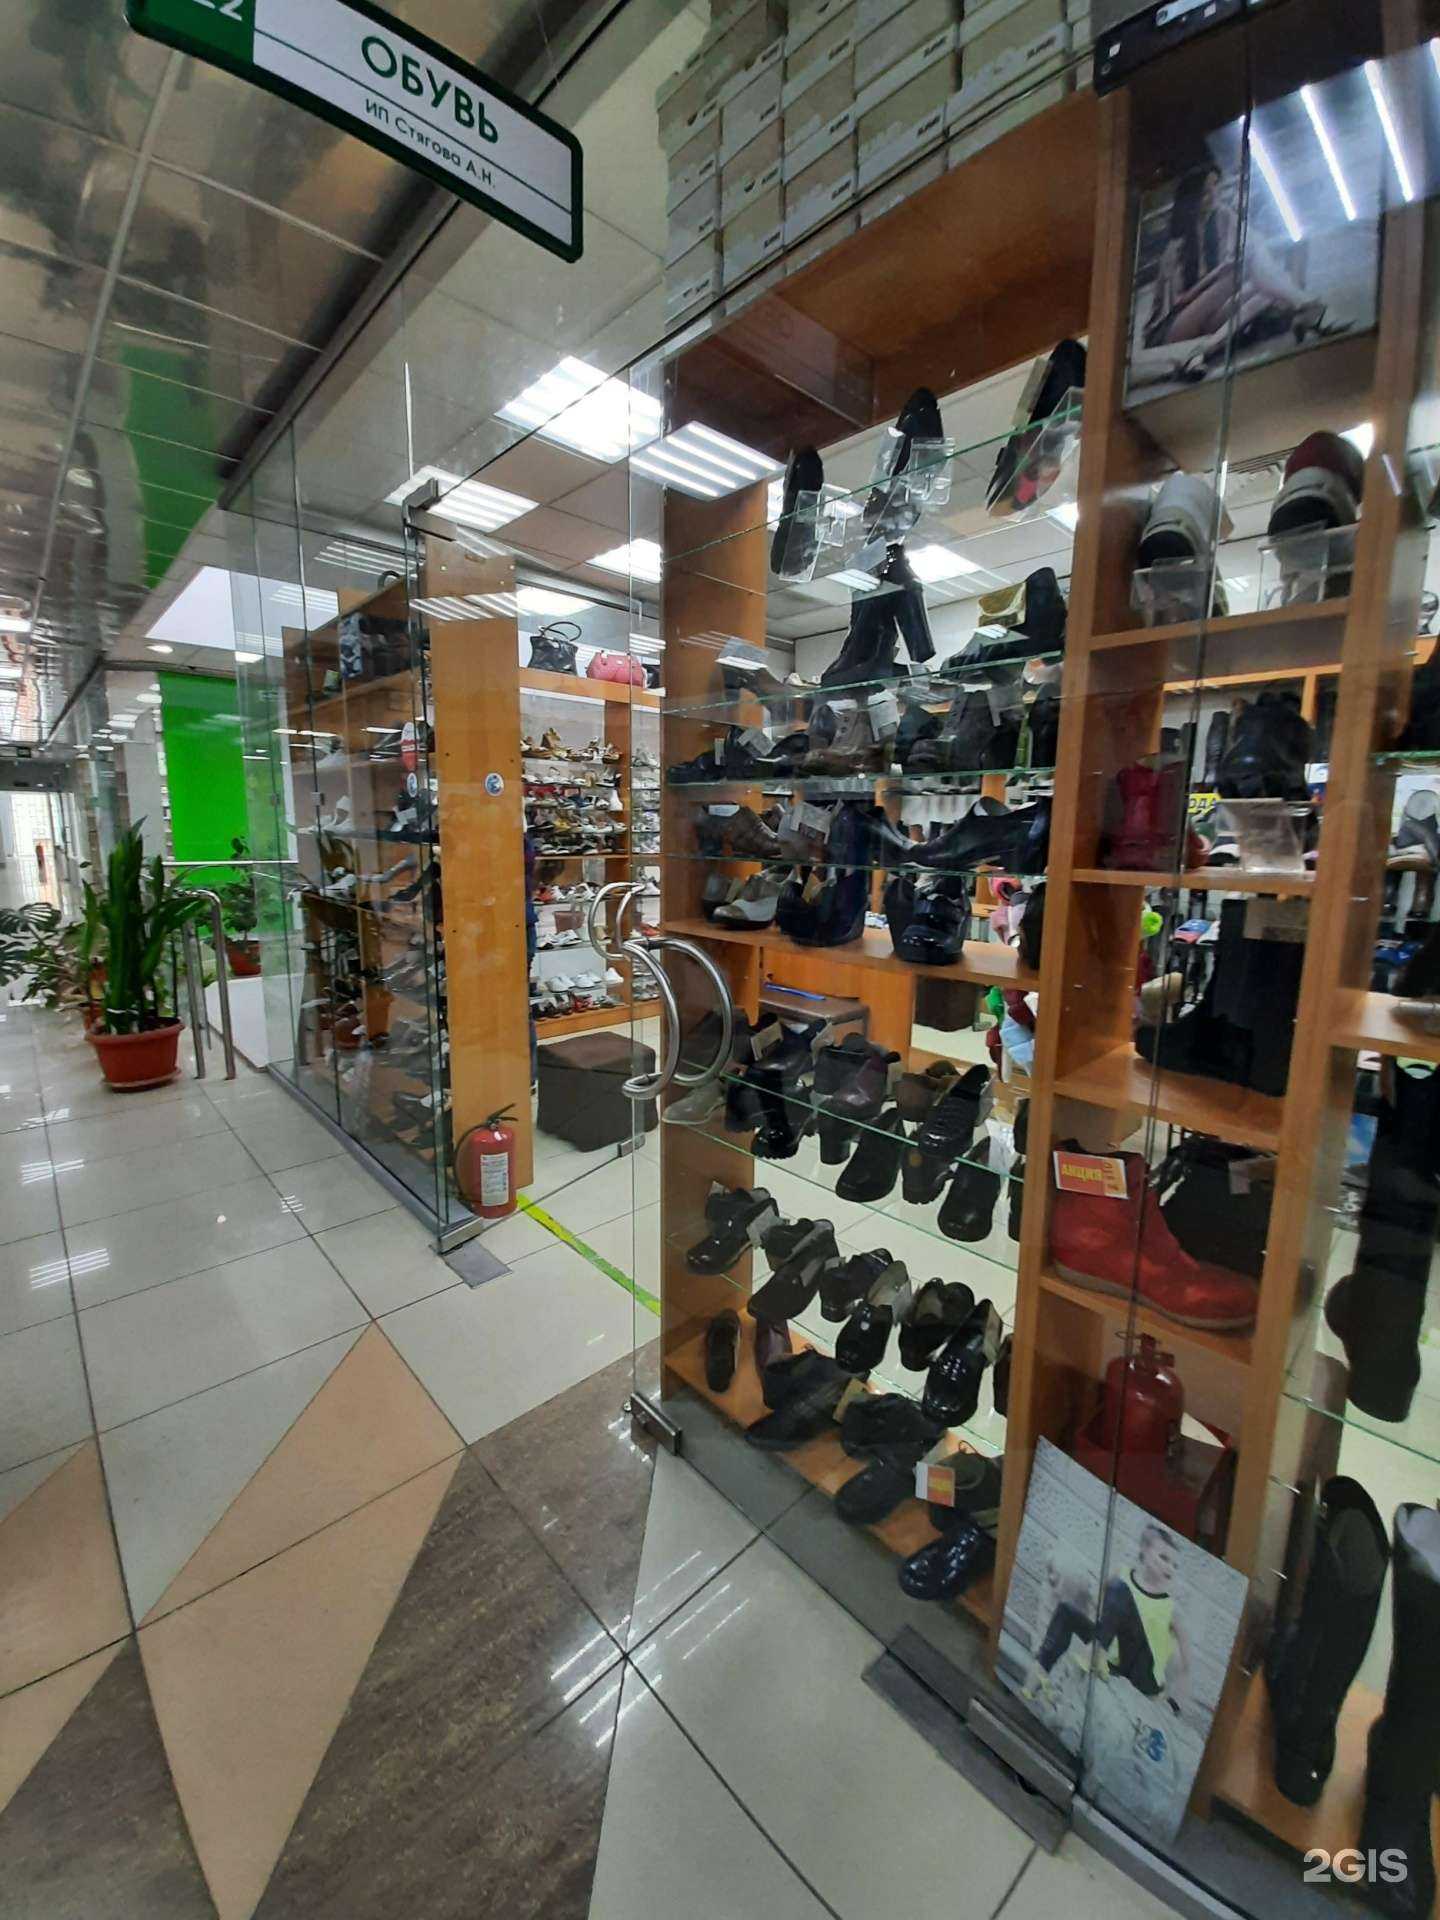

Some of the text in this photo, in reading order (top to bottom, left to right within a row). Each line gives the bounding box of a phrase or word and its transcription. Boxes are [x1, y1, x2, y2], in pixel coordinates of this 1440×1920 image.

[361, 36, 499, 144] ОБУВЬ
[366, 98, 389, 123] ИП
[395, 117, 461, 167] Стягова
